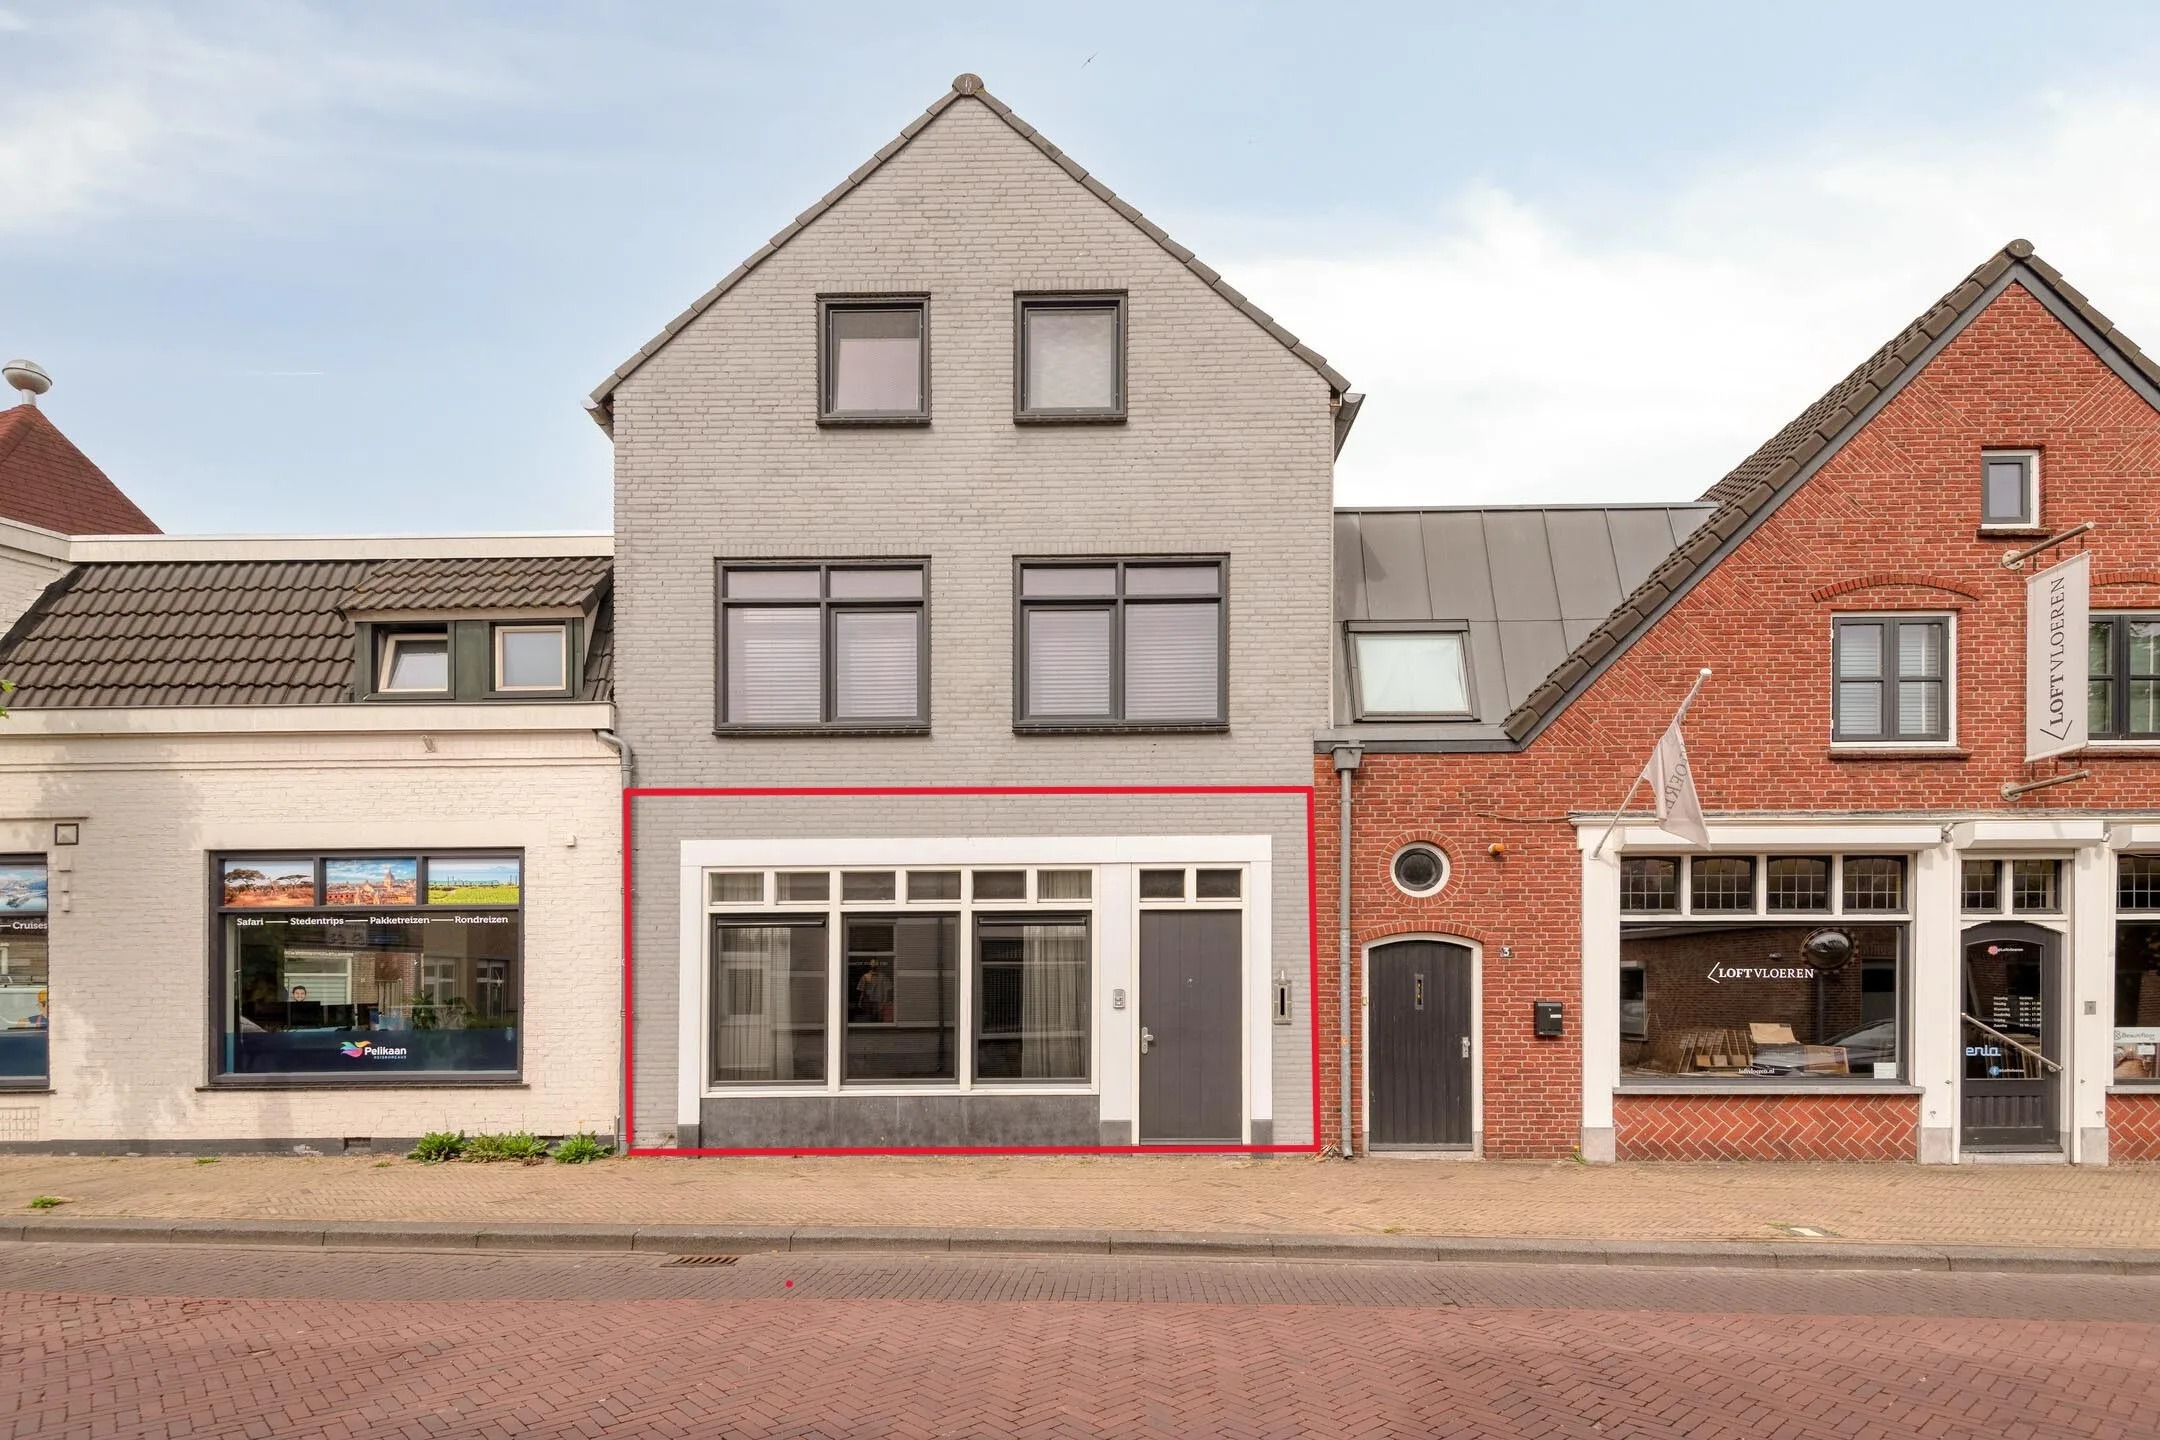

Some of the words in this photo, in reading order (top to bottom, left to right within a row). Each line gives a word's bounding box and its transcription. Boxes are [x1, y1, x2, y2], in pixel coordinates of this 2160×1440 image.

[12, 921, 48, 930] Cruises
[236, 917, 264, 926] Safari
[290, 916, 344, 927] Stedentrips
[369, 915, 430, 925] Pakketreizen
[454, 915, 509, 924] Rondreizen
[364, 1046, 407, 1055] Pelikaan
